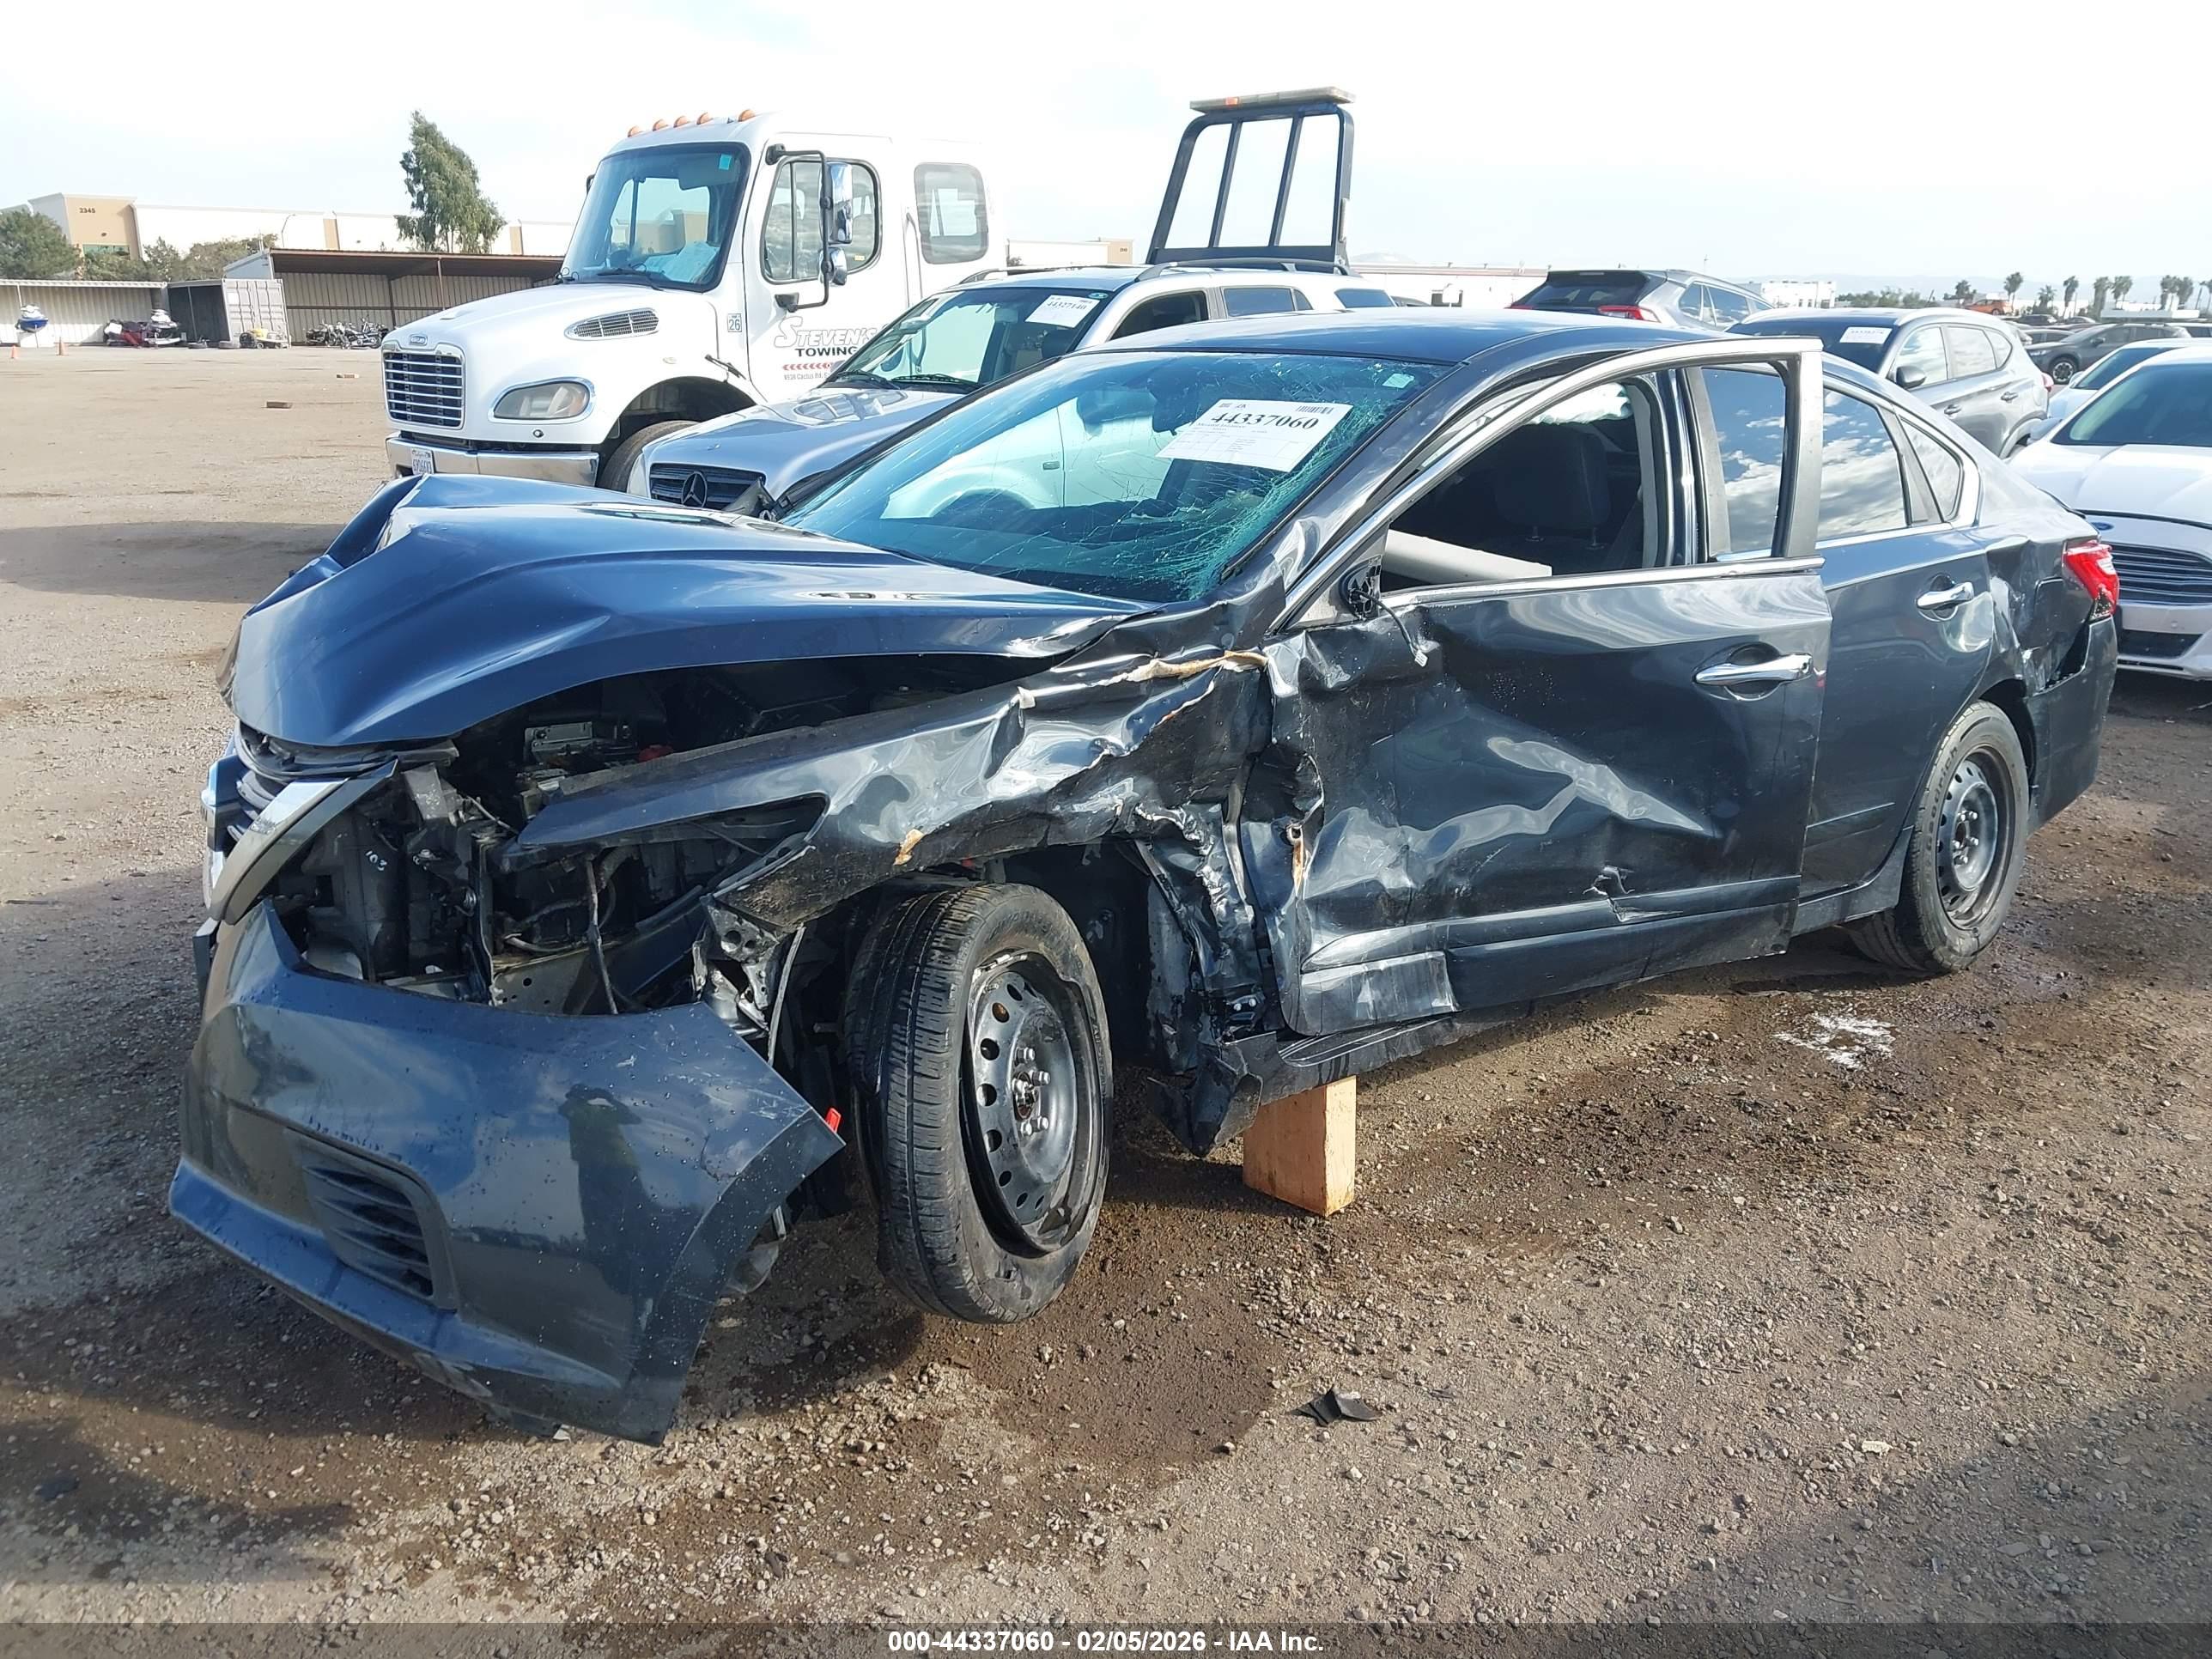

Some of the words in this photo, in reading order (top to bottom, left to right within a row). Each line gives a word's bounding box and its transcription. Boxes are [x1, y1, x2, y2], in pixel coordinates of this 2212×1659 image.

[728, 319, 740, 331] 26
[794, 346, 858, 357] TOWING
[1211, 412, 1319, 429] 44337060
